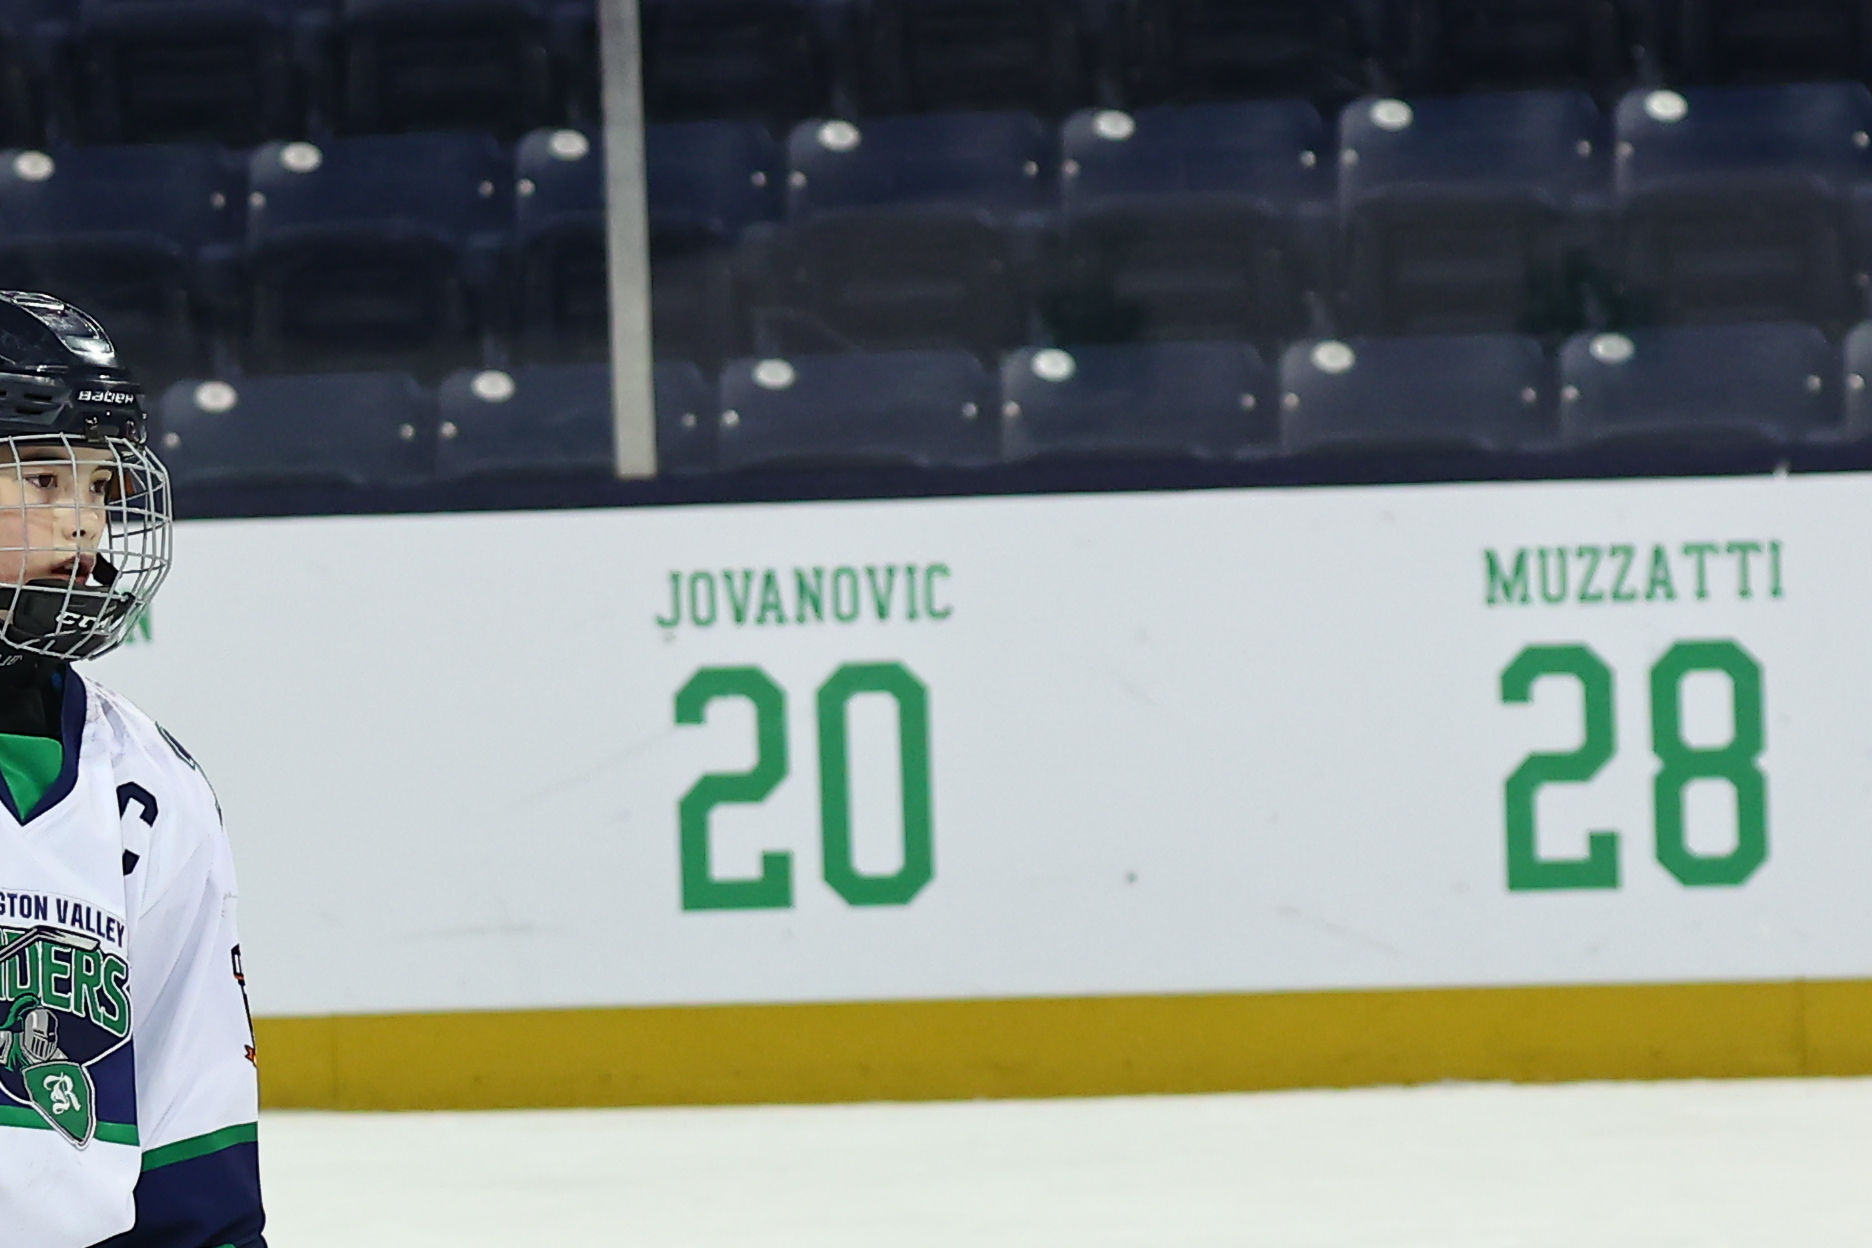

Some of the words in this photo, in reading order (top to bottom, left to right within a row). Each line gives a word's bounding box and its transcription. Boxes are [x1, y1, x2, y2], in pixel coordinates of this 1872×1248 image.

[655, 563, 953, 628] JOVANOVIC
[1484, 540, 1784, 606] MUZZATTI
[673, 660, 936, 911] 20
[1500, 638, 1770, 892] 28
[56, 898, 125, 948] VALLEY
